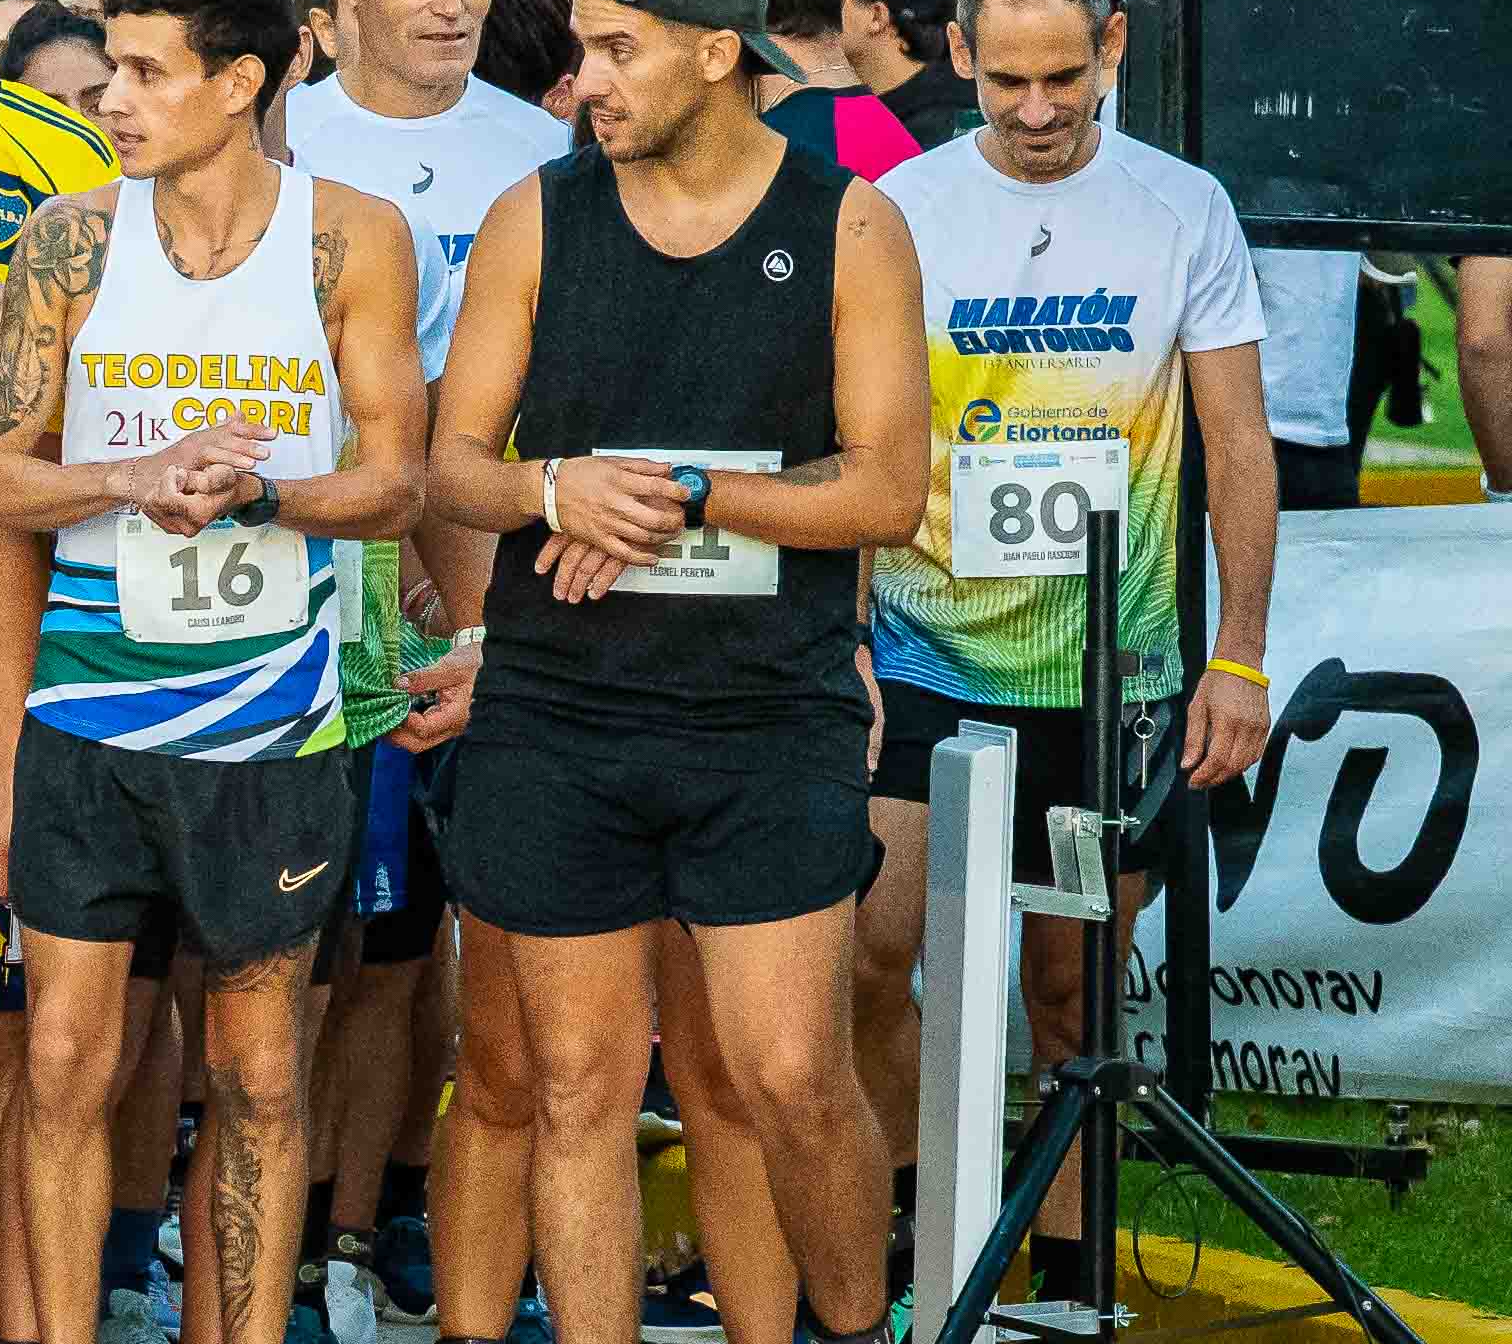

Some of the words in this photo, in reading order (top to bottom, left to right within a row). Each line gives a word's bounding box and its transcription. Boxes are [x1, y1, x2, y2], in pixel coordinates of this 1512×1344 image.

[948, 287, 1139, 329] MARATÓN
[947, 327, 1135, 357] ELORTONDO
[81, 354, 325, 396] TEODELINA
[1087, 404, 1108, 418] de
[1006, 424, 1120, 442] Elortondo
[989, 481, 1092, 544] 80
[169, 542, 265, 611] 16
